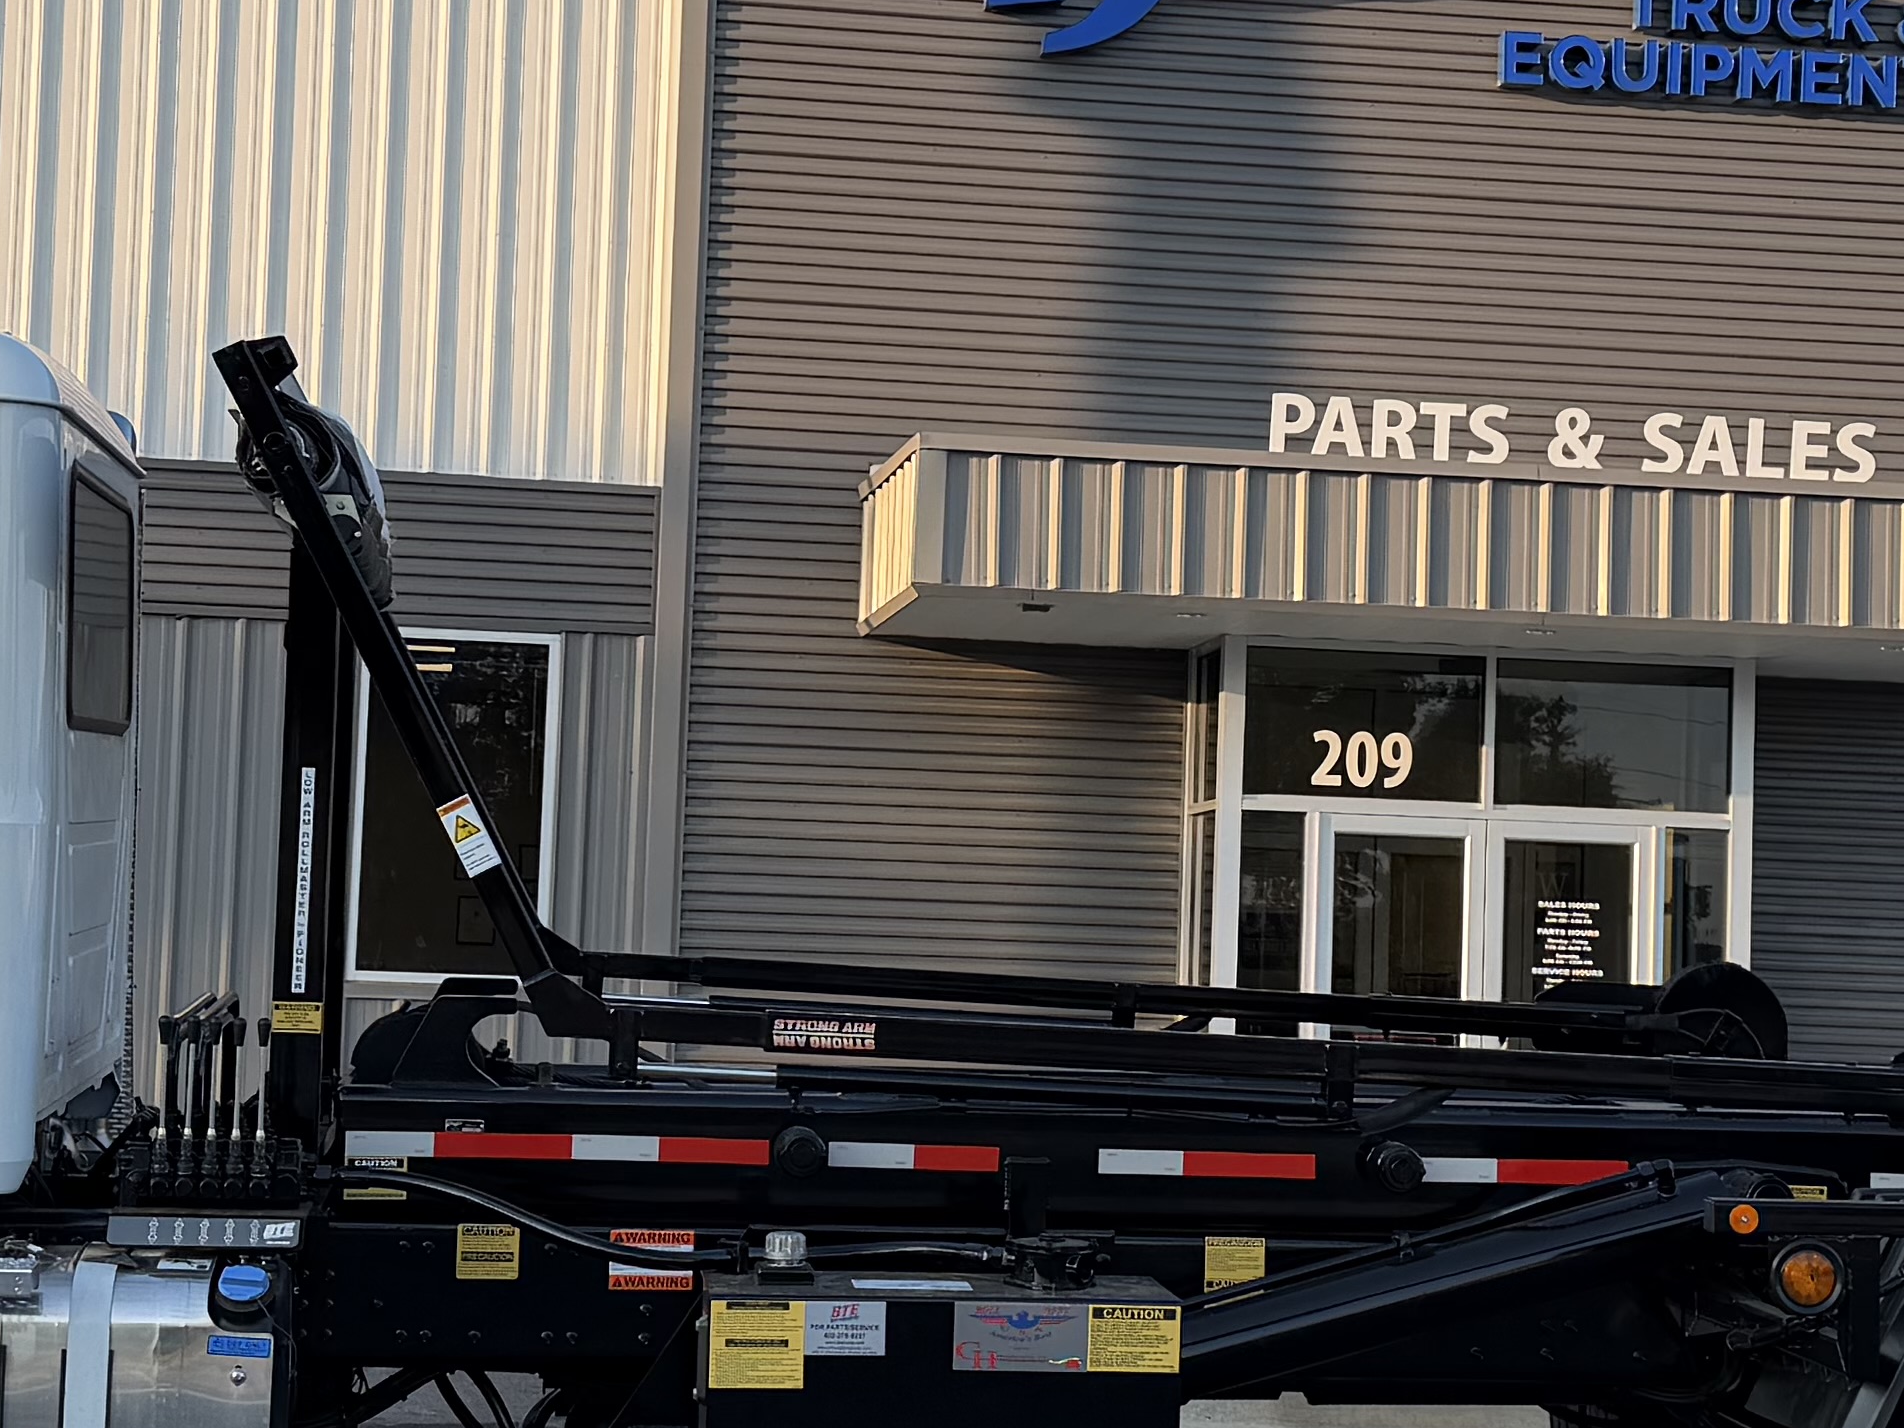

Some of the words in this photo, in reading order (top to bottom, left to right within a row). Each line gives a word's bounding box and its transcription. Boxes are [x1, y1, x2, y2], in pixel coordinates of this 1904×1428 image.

[1269, 390, 1511, 464] PARTS
[1546, 406, 1606, 469] &
[1640, 412, 1879, 483] SALES
[1310, 728, 1414, 789] 209
[1538, 900, 1567, 909] SALES
[1568, 902, 1601, 910] HOURS
[1536, 927, 1566, 936] PARTS
[1567, 929, 1600, 938] HOURS
[1571, 968, 1604, 977] HOURS
[773, 1018, 839, 1032] STRONG
[842, 1022, 876, 1034] ARM
[624, 1232, 691, 1244] WARNING
[623, 1276, 690, 1288] WARNING
[831, 1303, 860, 1319] BTE
[1103, 1308, 1165, 1320] CAUTION
